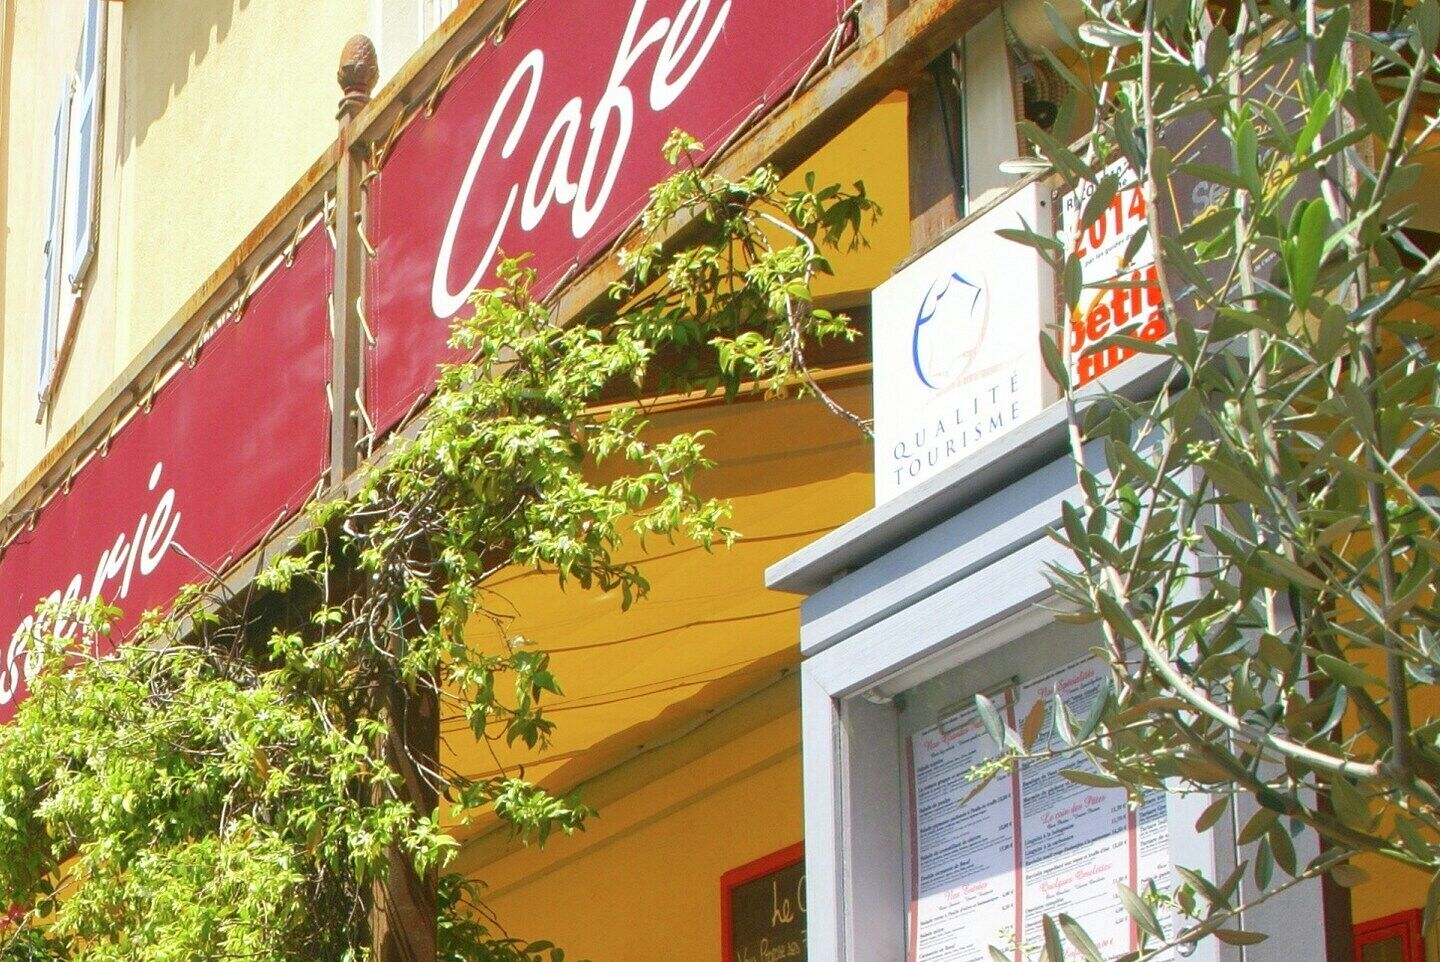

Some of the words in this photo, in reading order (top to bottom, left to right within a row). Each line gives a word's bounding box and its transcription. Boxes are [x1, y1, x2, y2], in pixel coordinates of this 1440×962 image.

[1105, 239, 1124, 255] guides
[892, 369, 1020, 462] QUALITÉ
[892, 401, 1020, 486] TOURISME
[772, 881, 794, 927] Le
